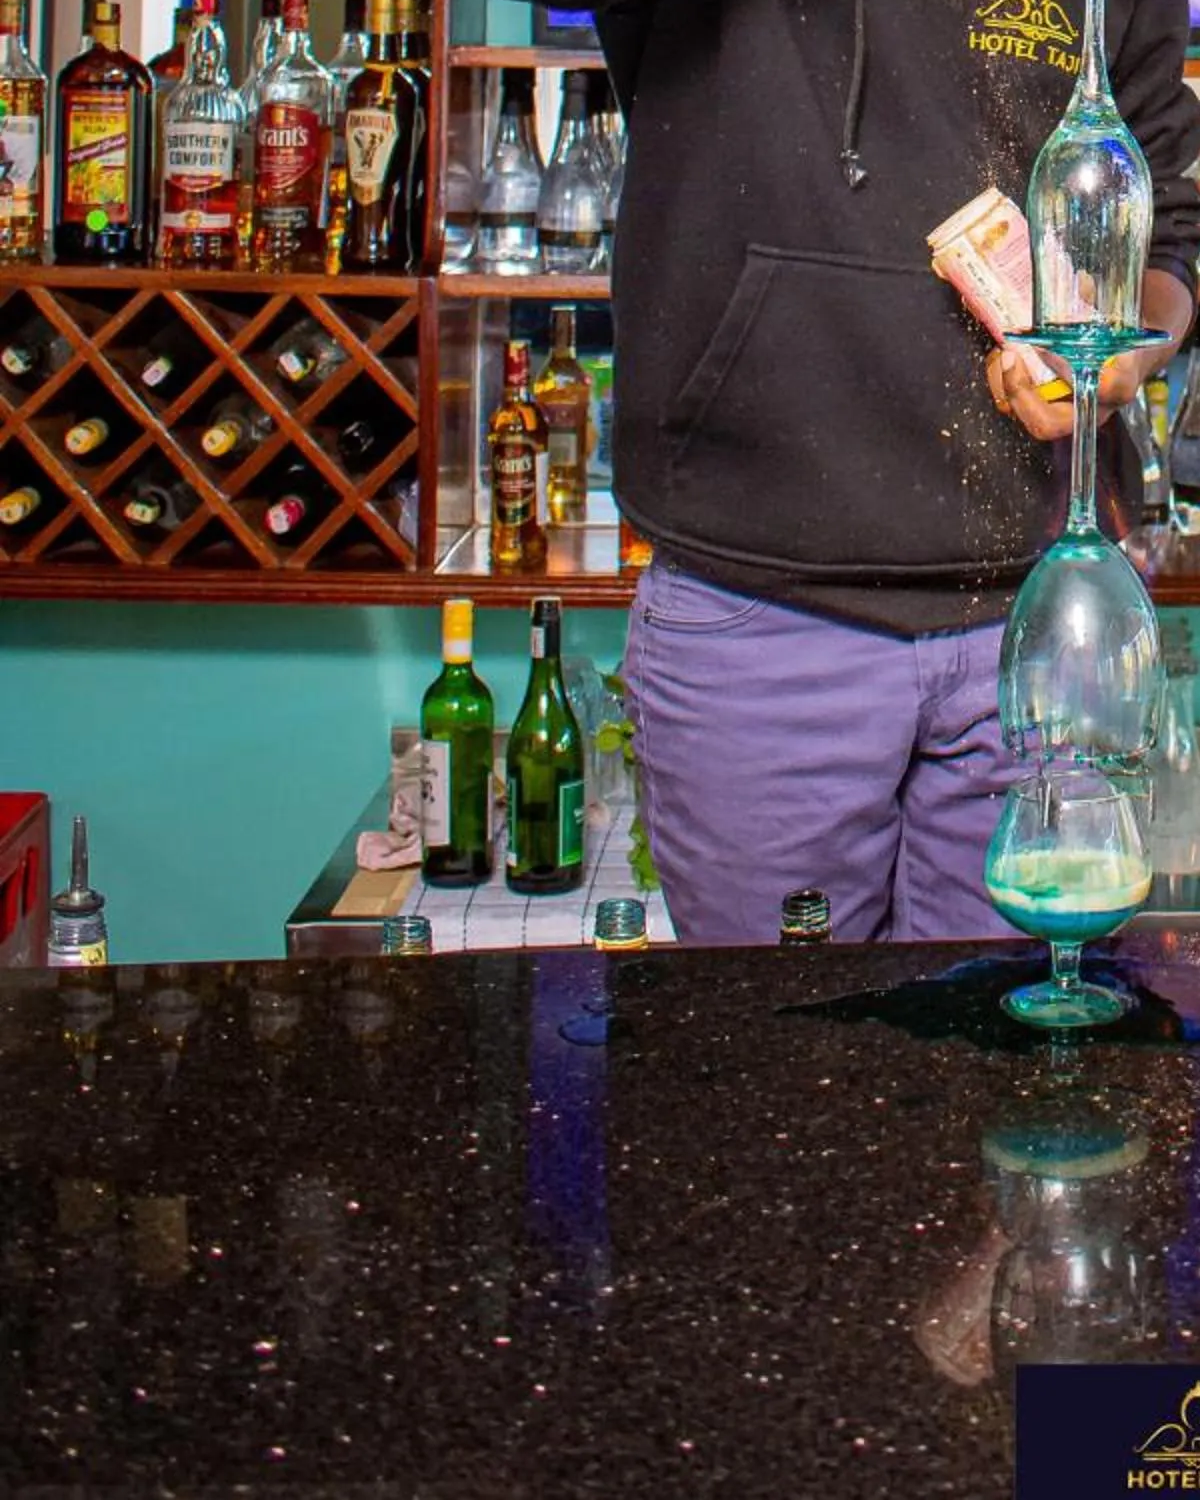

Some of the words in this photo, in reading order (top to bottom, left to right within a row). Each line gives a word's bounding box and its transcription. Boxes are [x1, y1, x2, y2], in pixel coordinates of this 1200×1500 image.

[968, 31, 1038, 61] HOTEL
[1047, 45, 1083, 74] TAJI
[169, 151, 225, 166] COMFORT
